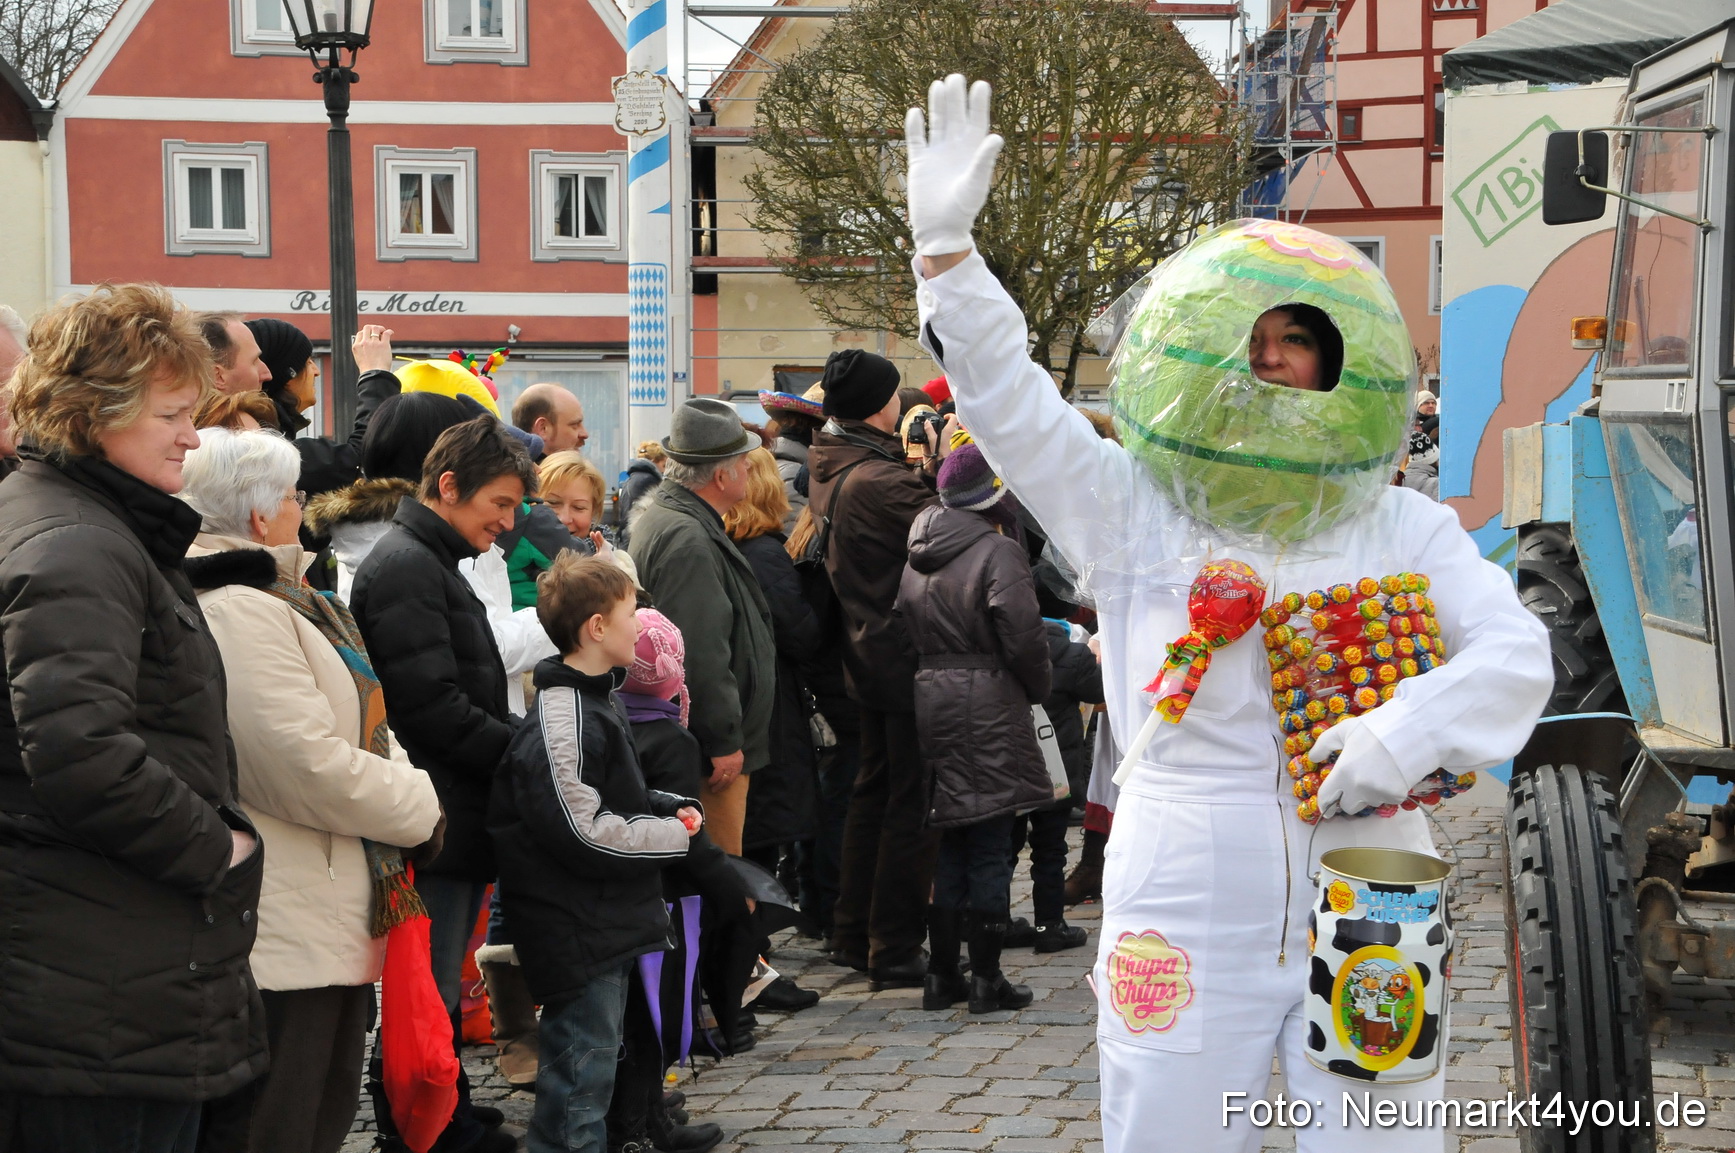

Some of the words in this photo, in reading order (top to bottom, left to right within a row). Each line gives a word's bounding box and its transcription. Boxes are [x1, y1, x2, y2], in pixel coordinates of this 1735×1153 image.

[376, 293, 467, 313] Moden
[1215, 587, 1248, 599] Lollies
[1116, 954, 1179, 983] Chupa
[1115, 979, 1178, 1020] Chups
